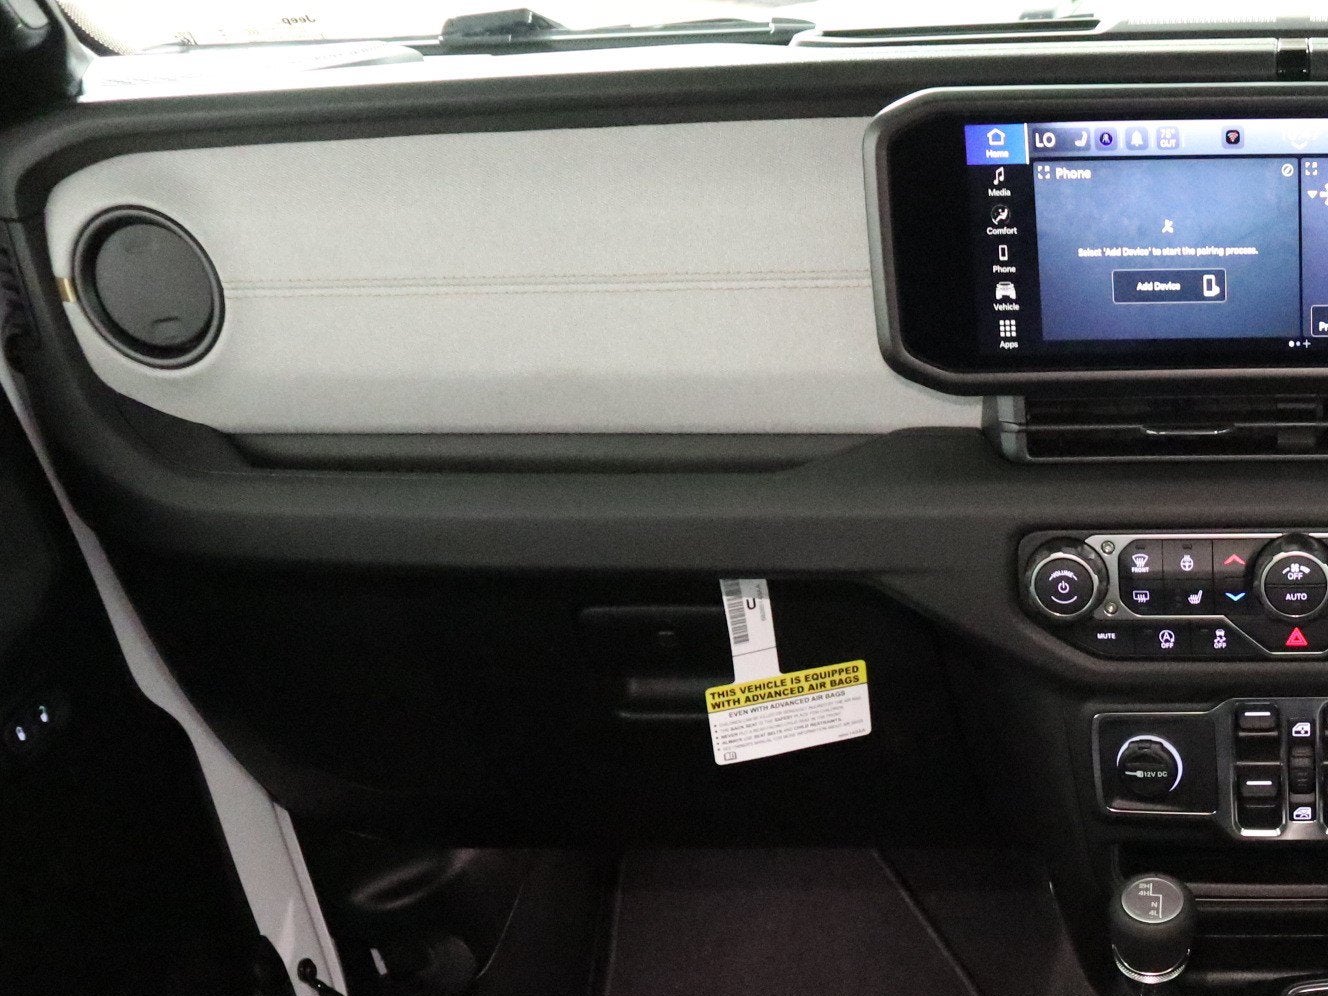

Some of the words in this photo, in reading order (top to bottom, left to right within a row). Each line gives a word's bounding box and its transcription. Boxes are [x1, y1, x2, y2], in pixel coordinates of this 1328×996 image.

[1035, 132, 1056, 148] LO
[986, 149, 1009, 158] Home
[1055, 167, 1092, 180] Phone
[988, 188, 1011, 197] Media
[986, 226, 1018, 235] Comfort
[993, 264, 1016, 274] Phone
[993, 303, 1020, 311] Vehicle
[999, 340, 1018, 350] Apps
[1287, 573, 1303, 581] OFF
[1286, 593, 1308, 601] AUTO
[746, 597, 756, 610] U
[710, 688, 737, 700] THIS
[740, 678, 787, 694] VEHICLE
[791, 676, 801, 684] IS
[804, 665, 859, 682] EQUIPPED
[711, 698, 740, 710] WITH
[744, 685, 804, 704] ADVANCED
[808, 681, 827, 692] AIR
[830, 675, 860, 688] BAGS
[728, 708, 749, 718] EVEN
[750, 704, 769, 714] WITH
[770, 697, 810, 709] ADVANCED
[825, 690, 846, 700] BAGS
